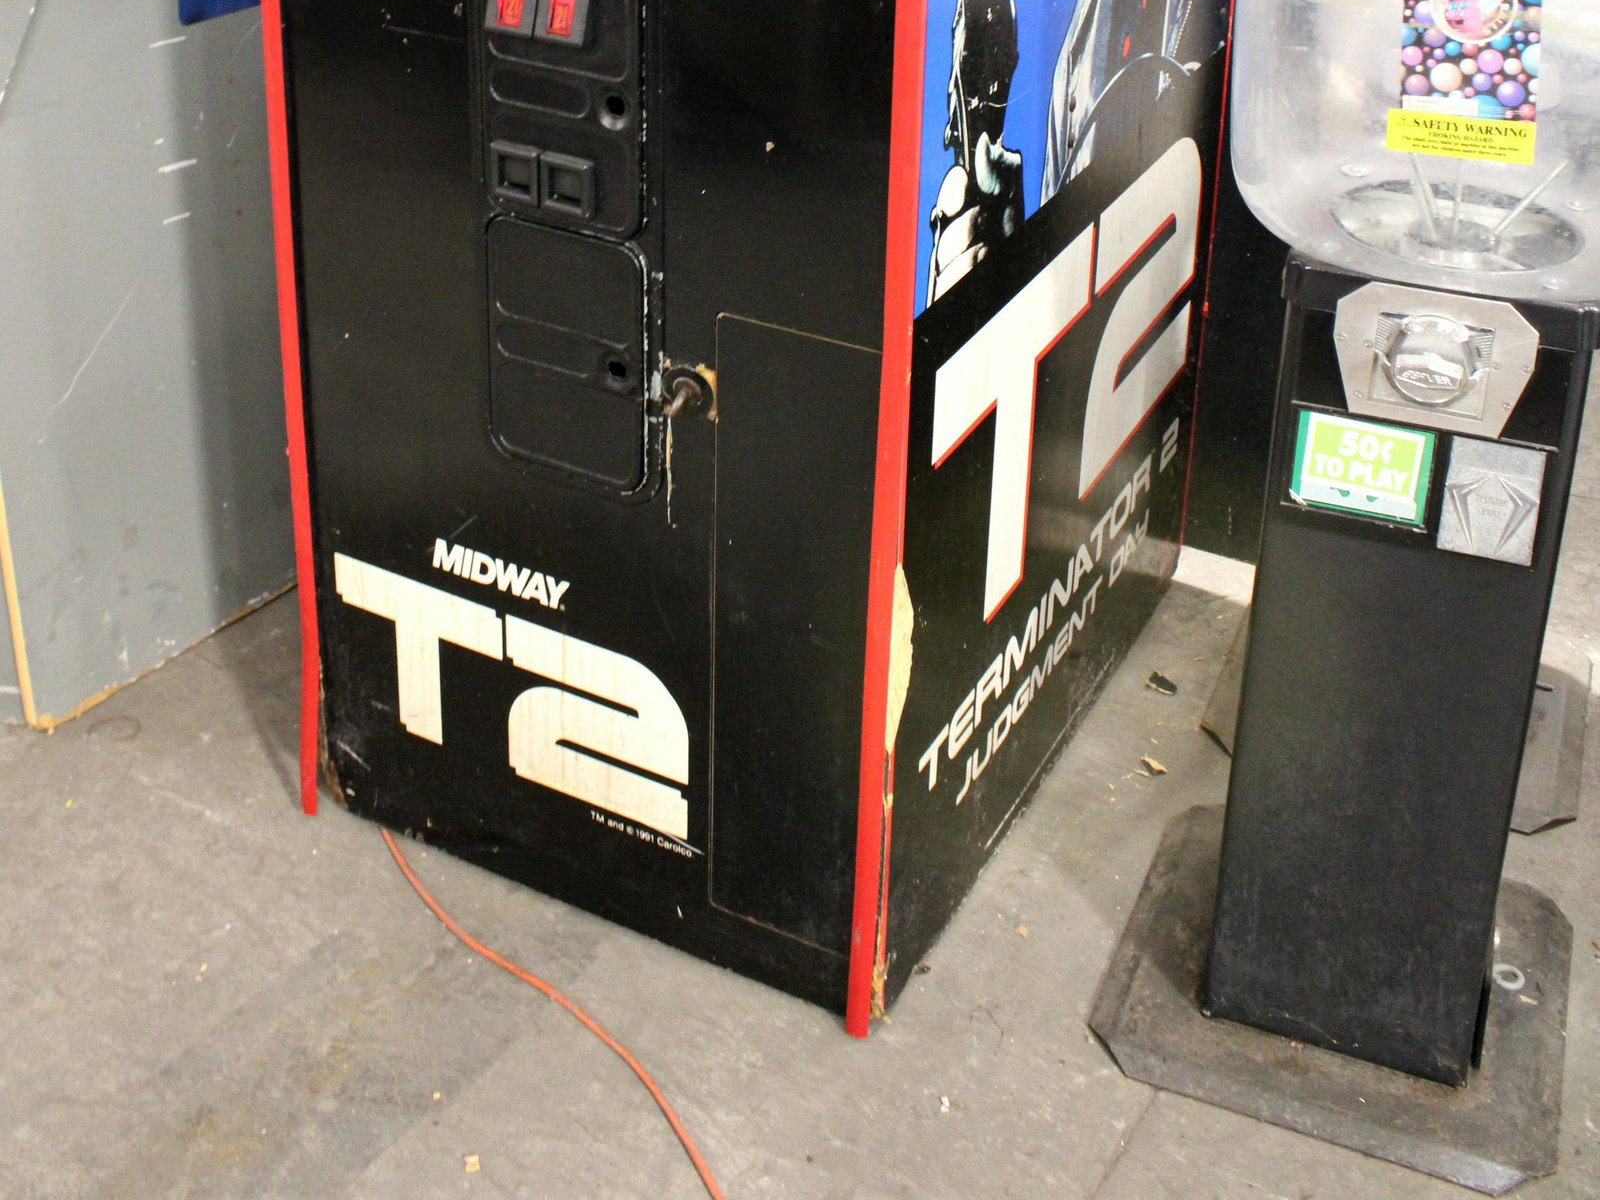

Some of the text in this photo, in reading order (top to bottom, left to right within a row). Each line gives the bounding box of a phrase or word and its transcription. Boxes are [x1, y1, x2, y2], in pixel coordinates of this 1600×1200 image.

[1413, 118, 1528, 139] SAFETY WARNING
[931, 136, 1202, 623] T2
[1314, 452, 1409, 492] TO PLAY
[433, 538, 571, 610] MIDWAY
[918, 417, 1180, 791] TERMINATOR 2
[955, 507, 1150, 806] JUDGMENT DAY
[334, 552, 689, 840] T2
[590, 810, 605, 824] TM
[607, 818, 624, 832] and
[636, 828, 655, 844] 1991
